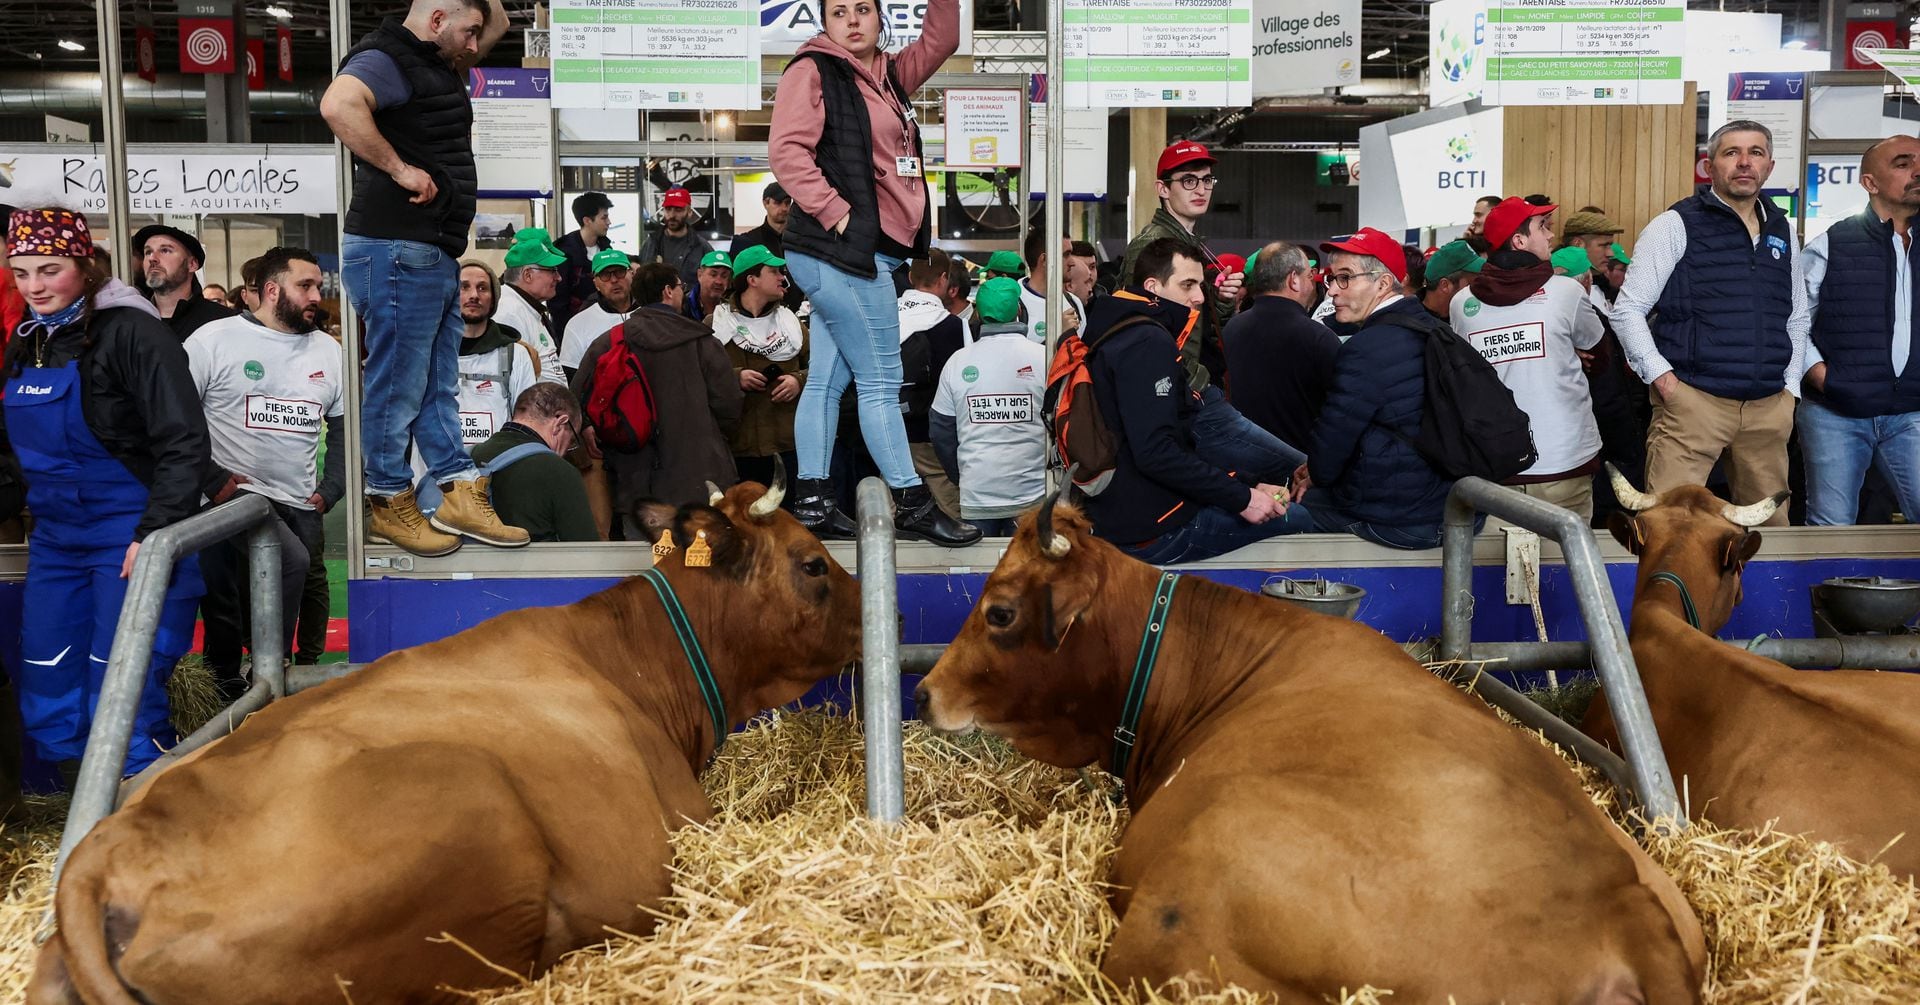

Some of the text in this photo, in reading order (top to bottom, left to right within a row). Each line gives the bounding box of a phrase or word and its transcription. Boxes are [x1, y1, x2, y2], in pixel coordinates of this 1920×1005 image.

[681, 0, 738, 8] FR7302216226
[1261, 11, 1340, 35] Village des
[678, 36, 686, 44] kg
[708, 36, 724, 44] jours
[1172, 34, 1180, 42] kg
[1201, 34, 1217, 42] jours
[1605, 33, 1613, 41] kg
[1252, 31, 1353, 57] professionnels
[1517, 61, 1537, 69] GAEC
[1538, 61, 1549, 69] DU
[1549, 61, 1569, 69] PETIT
[1634, 60, 1669, 68] MERCURY
[63, 158, 300, 195] Raes Locales
[1438, 170, 1486, 189] BCTI
[84, 199, 283, 210] NOELLE AQUITAINE
[1483, 330, 1525, 347] FIERS DE
[1480, 341, 1541, 359] OUS NOURRIR
[265, 402, 309, 416] FIERS DE
[971, 397, 1029, 410] SUR LA TÊTE
[250, 412, 279, 424] VOUS
[974, 410, 1026, 420] ON MARCHE
[466, 418, 478, 427] DE
[461, 429, 490, 438] OURRIR
[654, 544, 676, 555] 622
